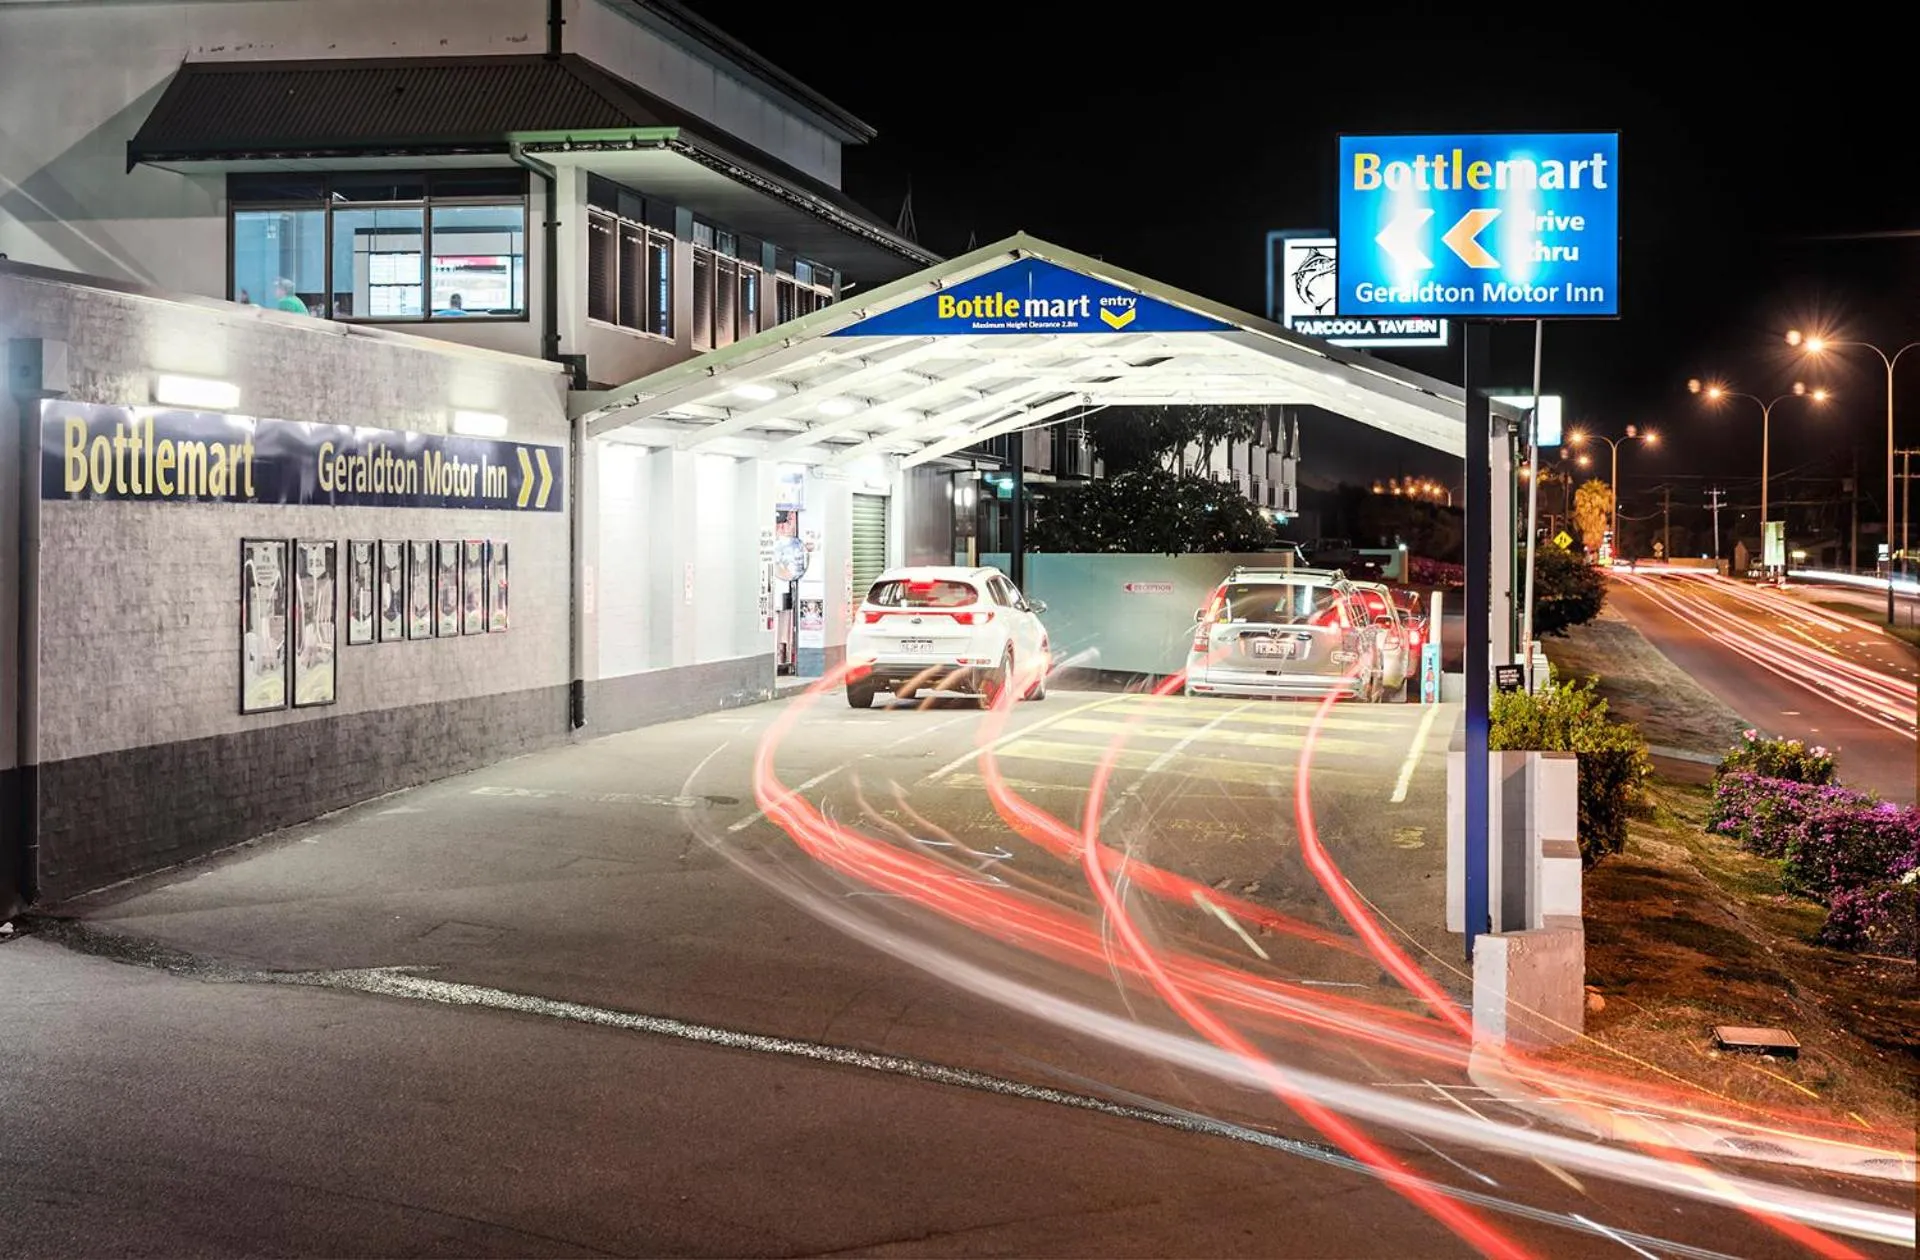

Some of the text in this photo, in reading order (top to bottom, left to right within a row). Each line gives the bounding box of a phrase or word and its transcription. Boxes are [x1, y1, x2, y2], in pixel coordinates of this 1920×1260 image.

[1354, 149, 1608, 191] Bottlemart
[938, 292, 1137, 318] Bottle mart entry
[1355, 282, 1604, 302] Geraldton Motor Inn
[972, 321, 1005, 329] Maximum
[1006, 321, 1028, 330] Height
[1294, 319, 1437, 335] TARCOOLA TAVERN
[64, 416, 255, 497] Bottlemart
[318, 441, 508, 498] Geraldton Motor Inn
